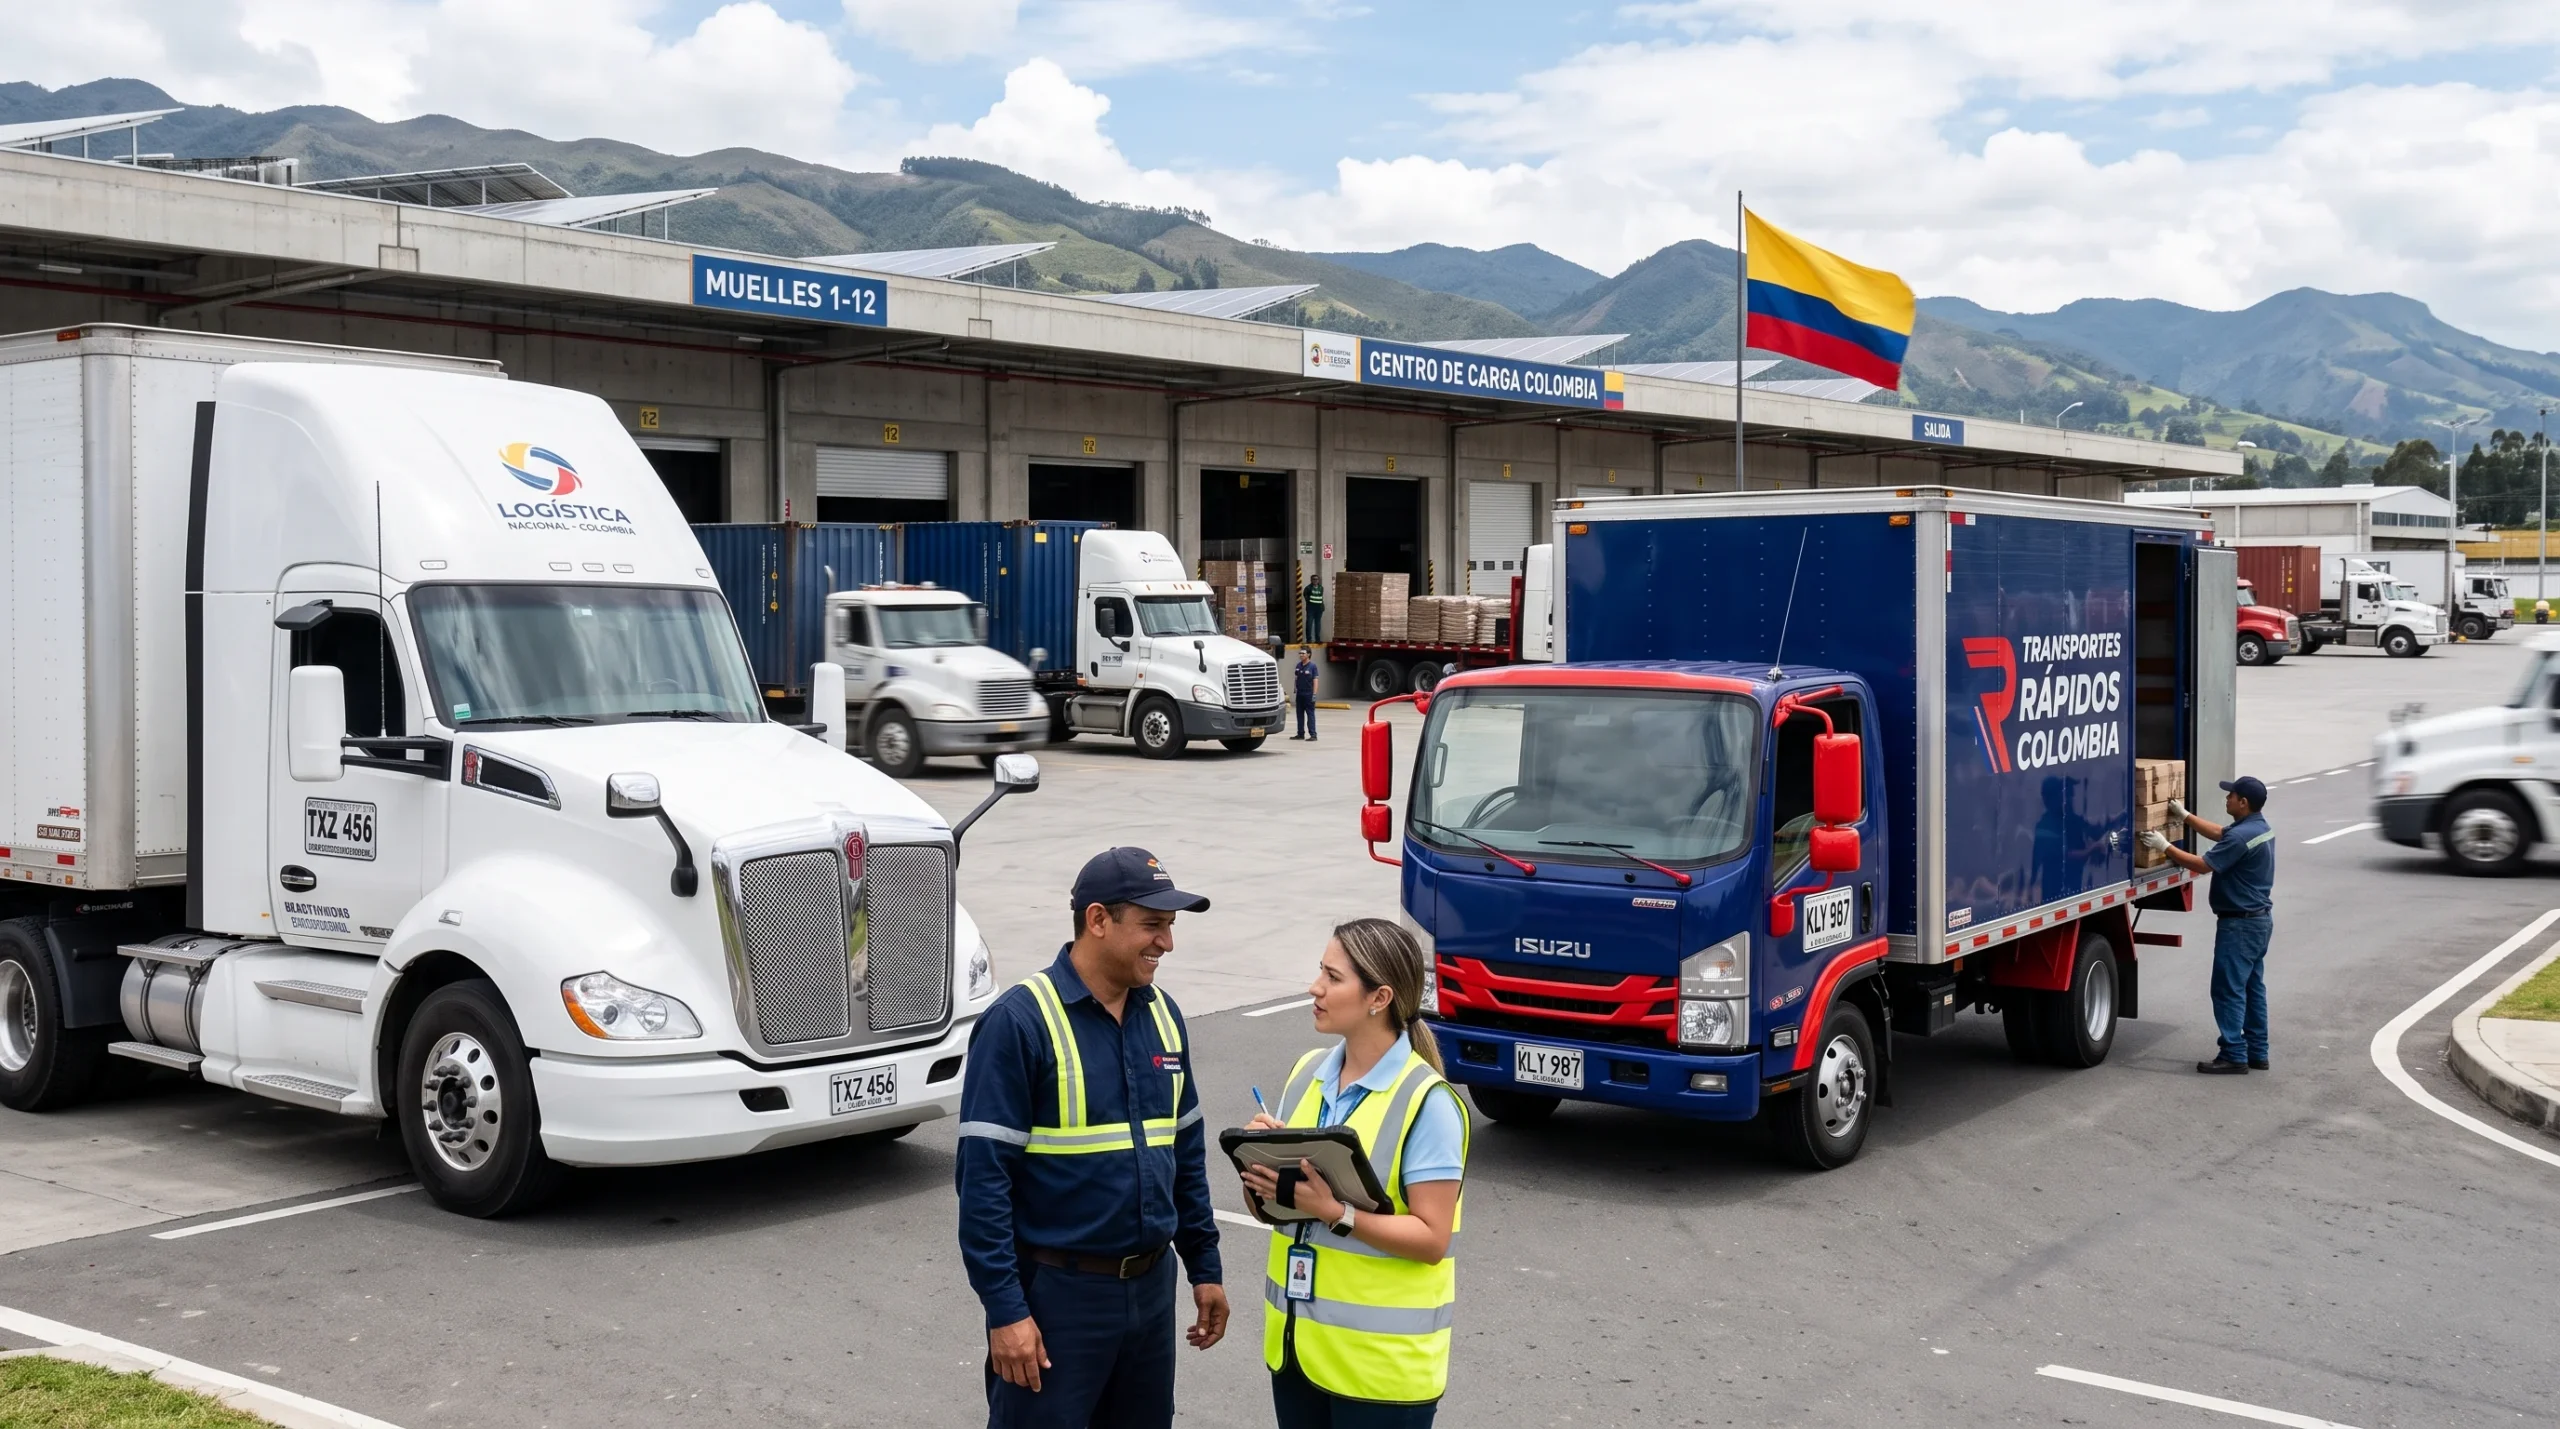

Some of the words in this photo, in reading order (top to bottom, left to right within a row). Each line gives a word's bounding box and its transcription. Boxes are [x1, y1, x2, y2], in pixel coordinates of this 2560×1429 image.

[706, 268, 822, 308] MUELLES
[830, 285, 876, 315] 1-12
[1370, 351, 1438, 382] CENTRO
[1442, 360, 1464, 385] DE
[1468, 364, 1521, 392] CARGA
[1524, 371, 1598, 400] COLOMBIA
[641, 411, 657, 425] 12
[1924, 421, 1952, 439] SALIDA
[497, 499, 632, 524] LOGÍSTICA
[508, 521, 570, 531] NACIONAL
[579, 523, 636, 535] COLOMBIA
[2022, 632, 2122, 663] TRANSPORTES
[2019, 664, 2121, 722] RÁPIDOS
[2017, 721, 2120, 771] COLOMBIA
[308, 808, 338, 839] TXZ
[343, 812, 373, 843] 456
[1806, 903, 1828, 936] KLY
[1830, 898, 1850, 929] 987
[1515, 937, 1591, 959] ISUZU
[1518, 1050, 1546, 1074] KLY
[1550, 1055, 1581, 1079] 987
[833, 1077, 863, 1103] TXZ
[866, 1072, 895, 1097] 456
